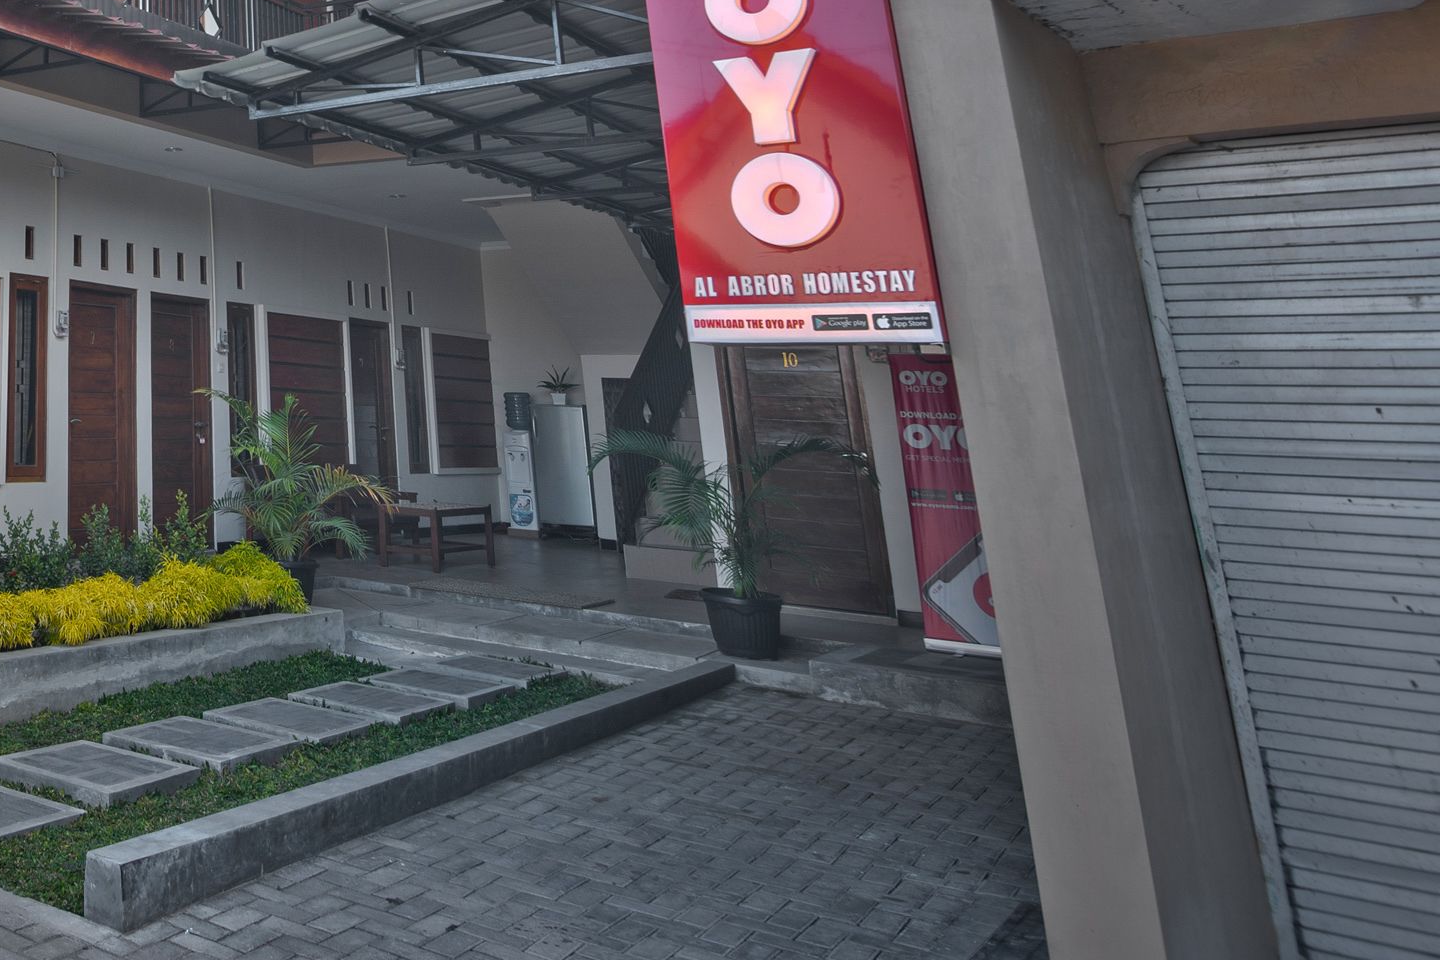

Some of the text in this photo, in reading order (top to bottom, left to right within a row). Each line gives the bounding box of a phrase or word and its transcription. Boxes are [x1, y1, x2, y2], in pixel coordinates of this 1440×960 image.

[695, 270, 915, 297] AL ABROR HOMESTAY
[694, 319, 805, 329] DOWNLOAD THE OYO APP
[781, 351, 799, 369] 10
[898, 370, 948, 387] OYO
[905, 385, 945, 394] HOTELS
[900, 410, 957, 420] DOWNLOAD
